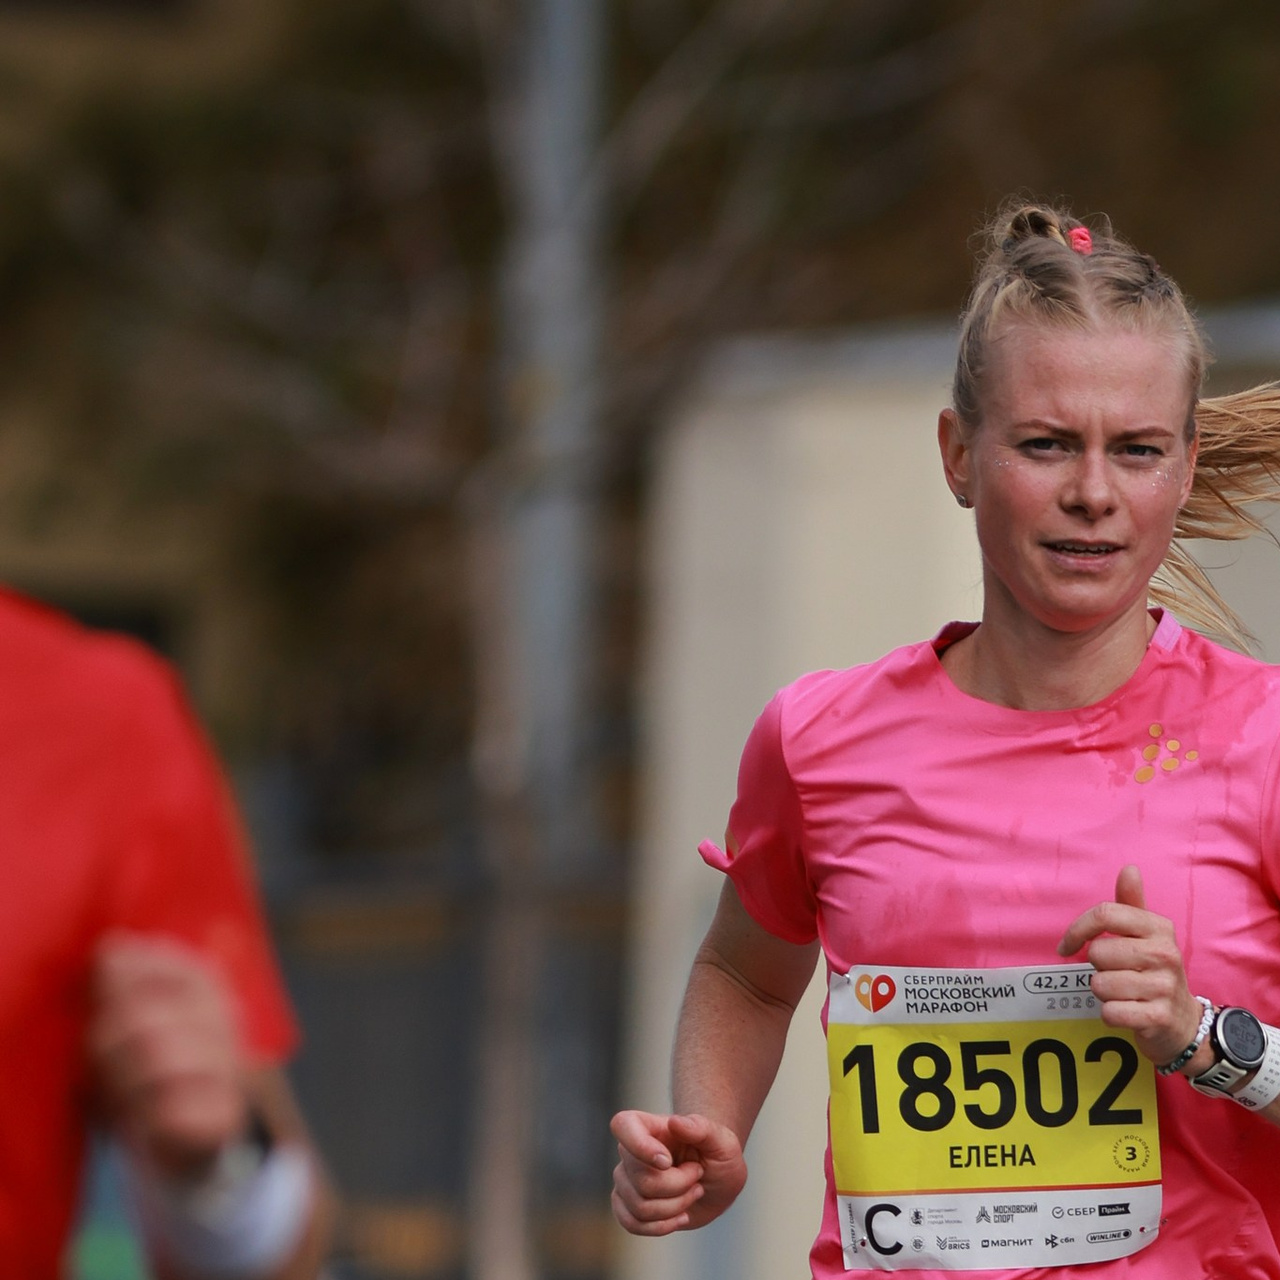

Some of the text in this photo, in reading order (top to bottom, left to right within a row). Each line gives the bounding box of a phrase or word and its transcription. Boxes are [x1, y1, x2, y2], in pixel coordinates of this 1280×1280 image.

[904, 974, 984, 986] СБЕРПРАЙМ
[1033, 974, 1069, 990] 42,2
[905, 984, 1015, 1000] МОСКОВСКИЙ
[906, 1001, 988, 1014] МАРАФОН
[1046, 996, 1096, 1010] 2026
[842, 1036, 1143, 1134] 18502
[949, 1144, 1036, 1169] ЕЛЕНА
[1125, 1146, 1137, 1161] 3
[993, 1202, 1038, 1214] МОСКОВСКИЙ
[1067, 1205, 1126, 1217] СБЕР Прайм
[993, 1214, 1014, 1224] СПОРТ
[1090, 1232, 1122, 1241] WINLINE
[948, 1242, 970, 1250] BRICS
